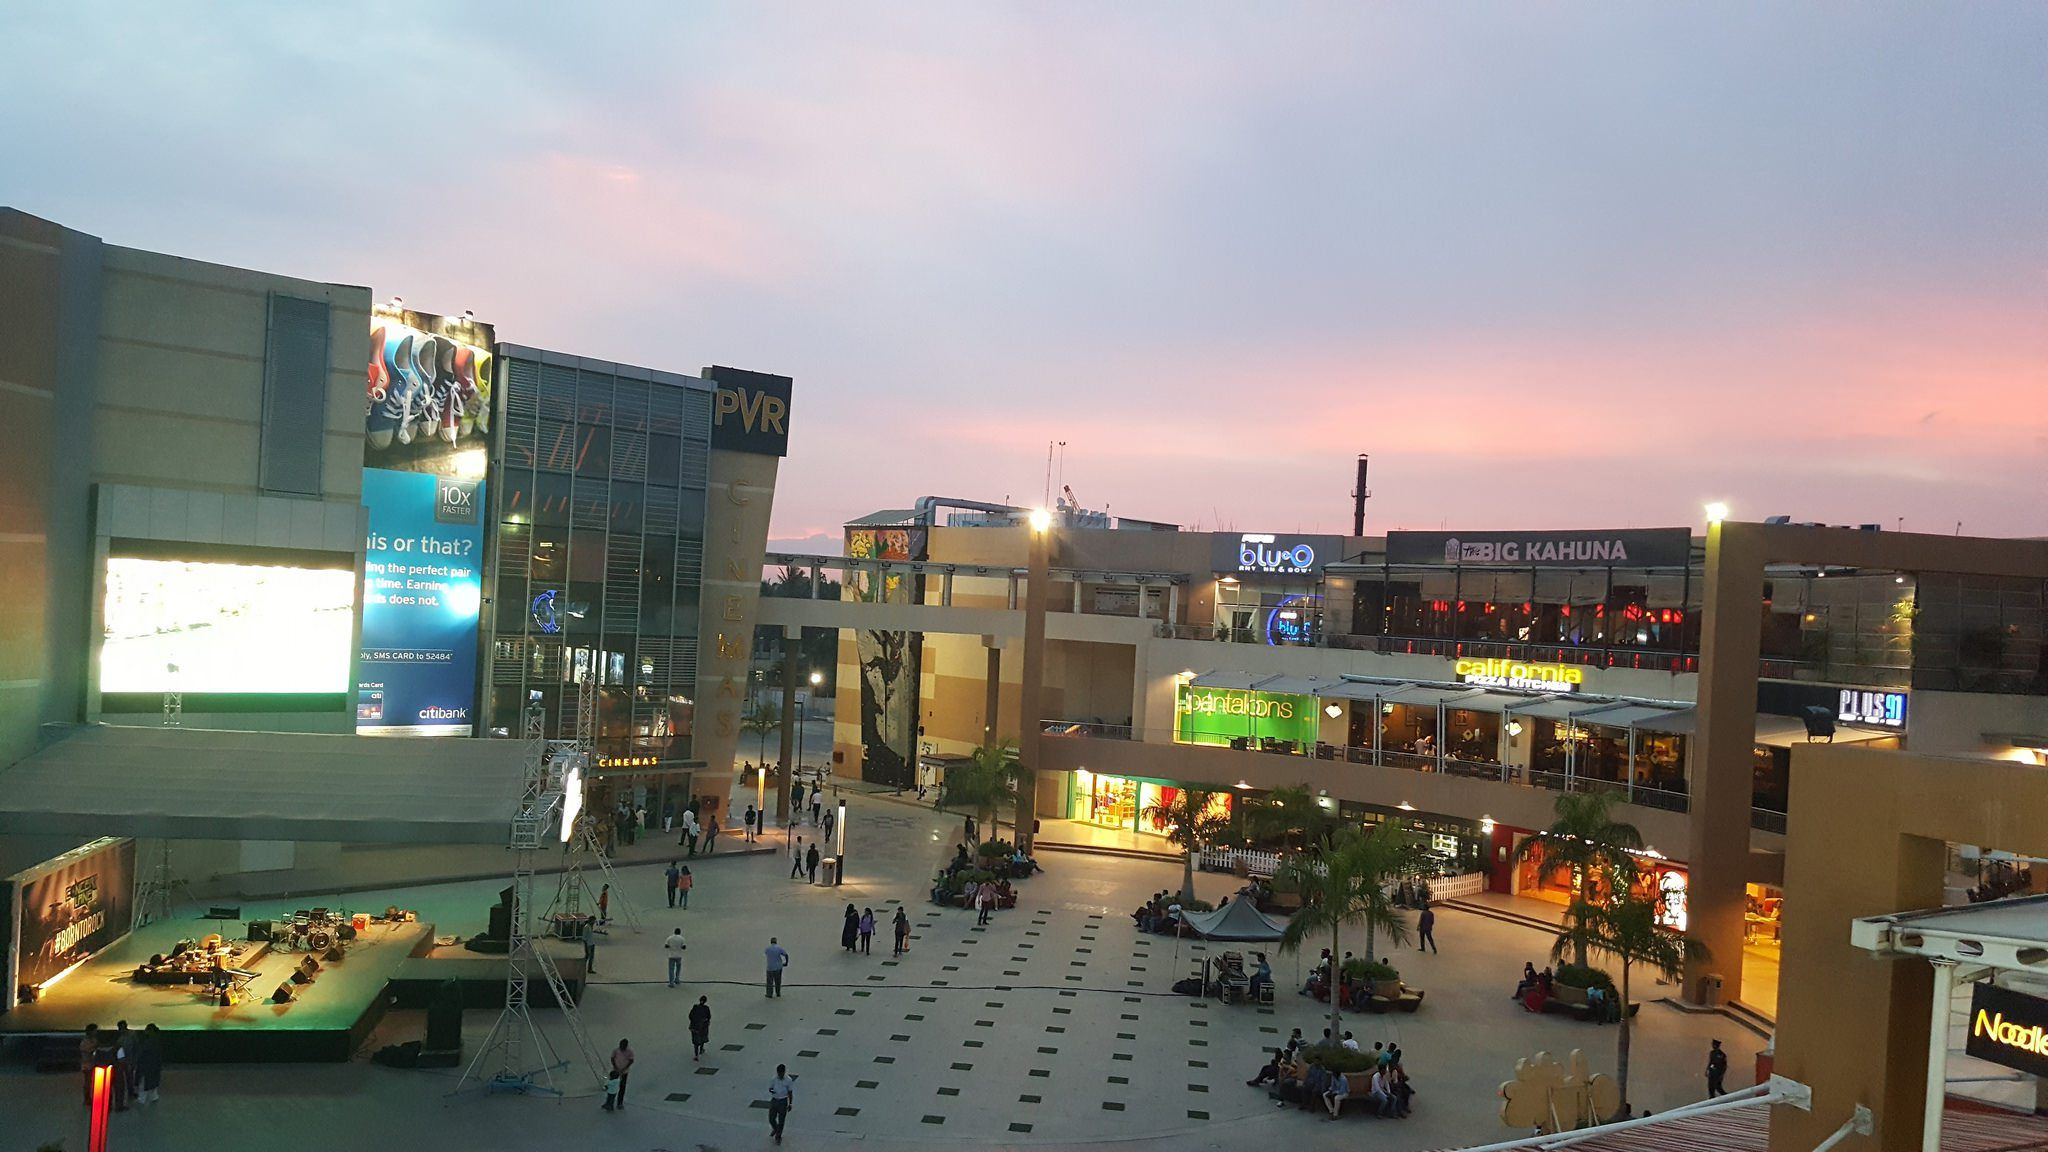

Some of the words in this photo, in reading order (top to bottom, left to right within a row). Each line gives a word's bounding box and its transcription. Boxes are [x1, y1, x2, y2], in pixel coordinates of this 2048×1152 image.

[714, 386, 785, 435] PVR
[442, 487, 471, 505] 10x
[442, 506, 471, 515] FASTER
[393, 537, 415, 552] or
[420, 535, 473, 556] that?
[1478, 541, 1519, 562] BIG
[1525, 540, 1628, 562] KAHUNA
[387, 562, 406, 574] the
[409, 564, 449, 576] perfect
[450, 567, 472, 578] pair
[389, 594, 415, 605] does
[373, 651, 391, 659] SMS
[392, 652, 415, 660] CARD
[416, 652, 424, 660] to
[1456, 658, 1581, 683] california
[419, 706, 467, 719] citibank
[599, 756, 658, 768] CINEMAS
[55, 910, 105, 954] #BORNTOROCK
